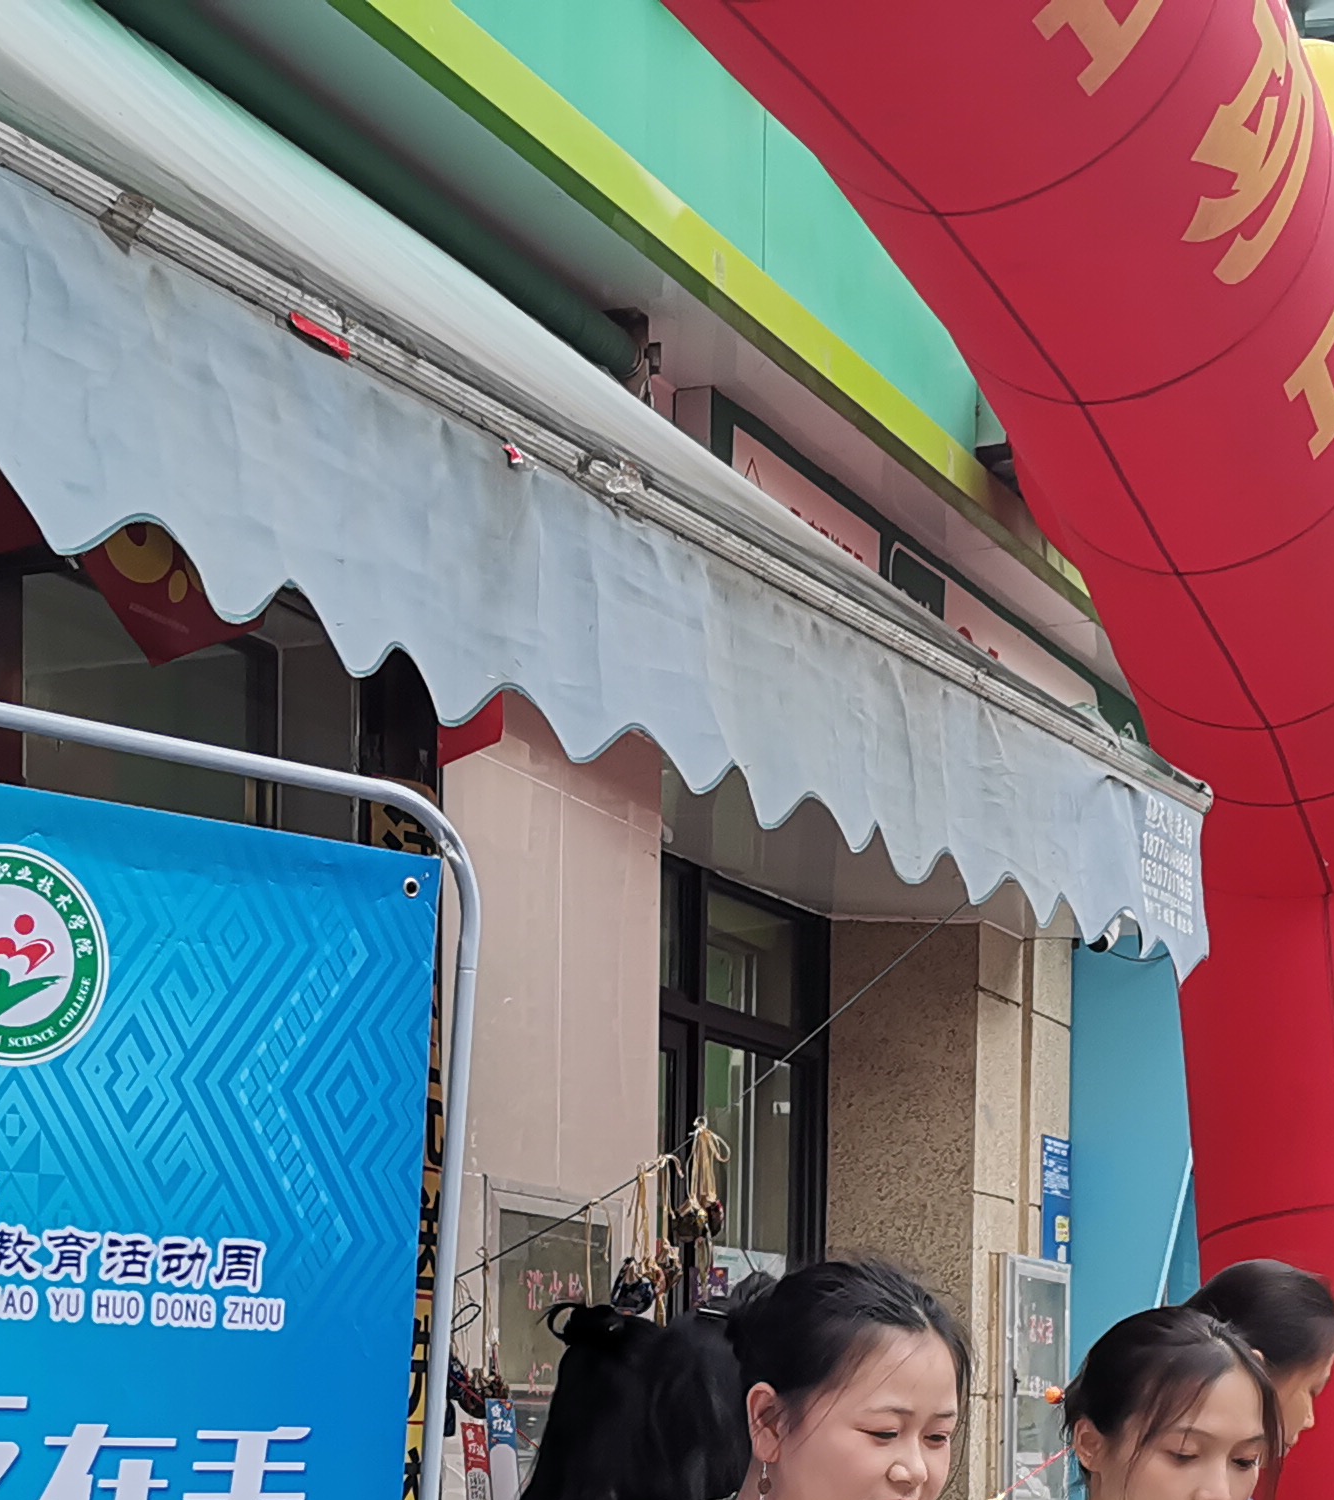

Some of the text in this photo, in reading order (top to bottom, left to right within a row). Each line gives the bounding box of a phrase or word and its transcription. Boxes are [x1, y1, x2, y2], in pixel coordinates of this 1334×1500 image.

[7, 1025, 57, 1048] SCIENCE
[58, 976, 92, 1029] COLLEGE
[51, 1291, 80, 1317] YU
[96, 1296, 141, 1320] HUO
[155, 1297, 213, 1323] DONG
[226, 1301, 284, 1327] ZHOU
